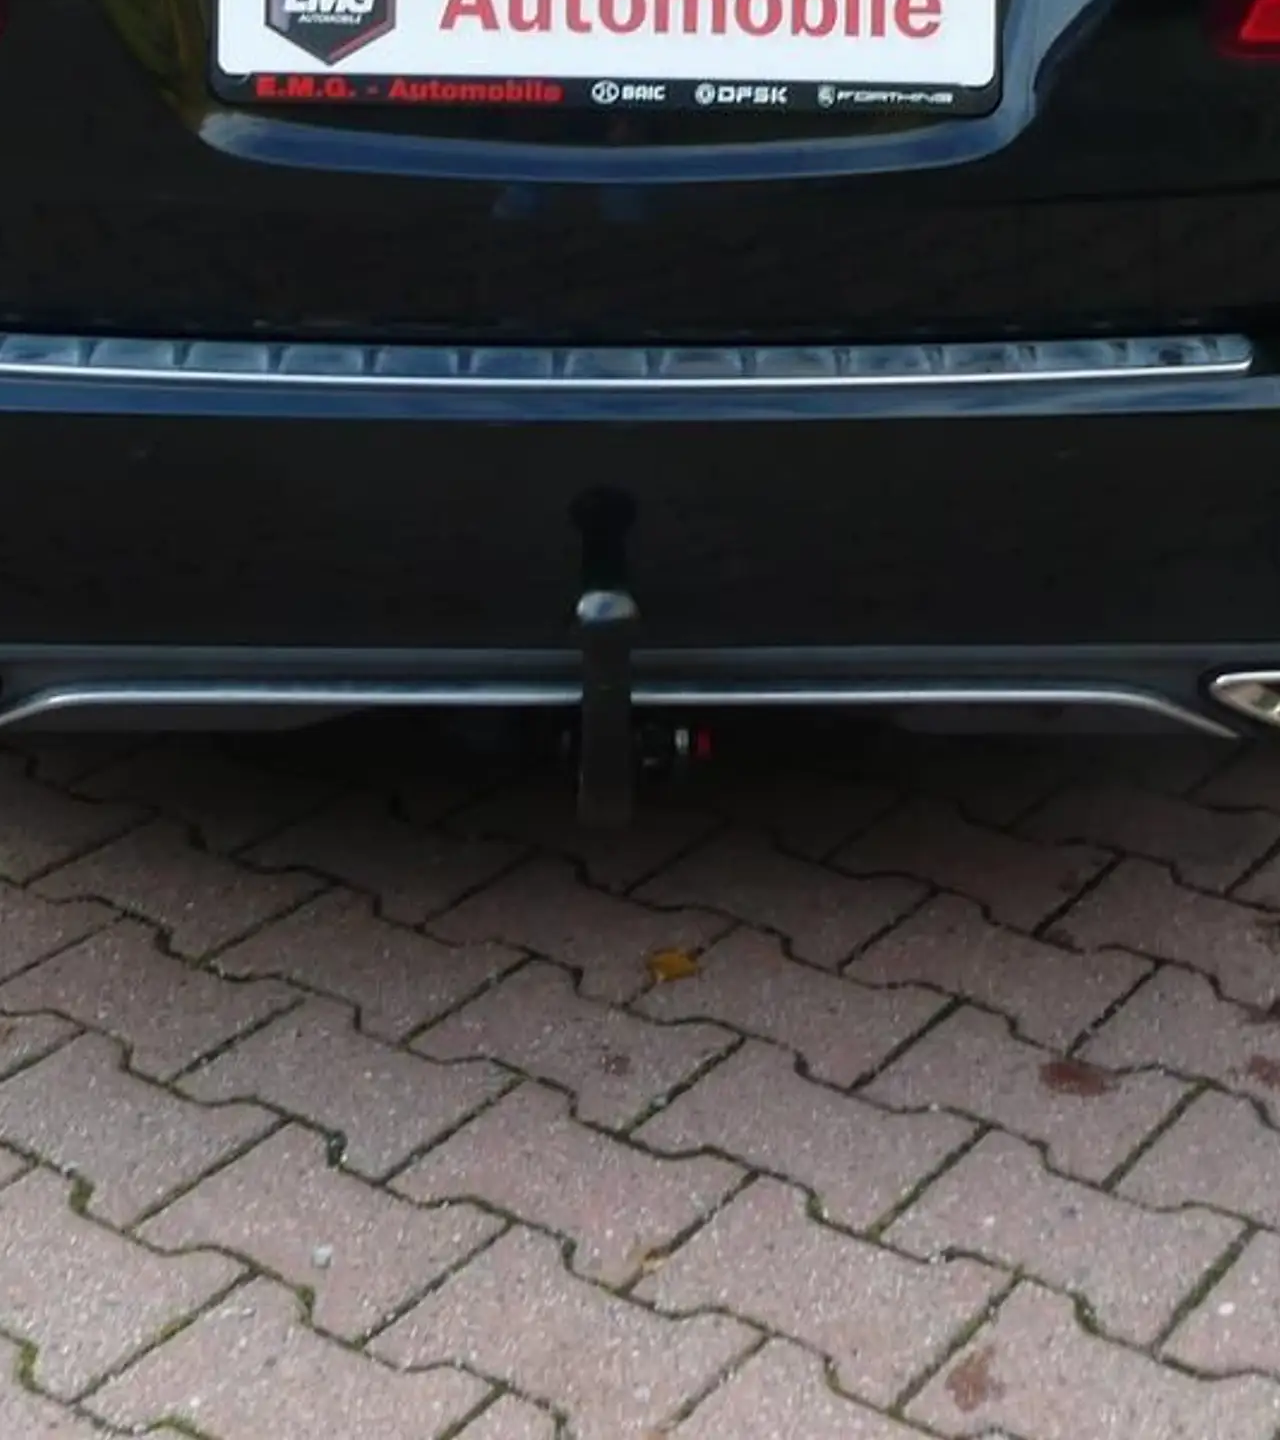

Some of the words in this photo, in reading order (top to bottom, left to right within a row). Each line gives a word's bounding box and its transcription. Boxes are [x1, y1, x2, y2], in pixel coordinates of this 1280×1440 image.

[387, 79, 565, 102] Automobile
[622, 84, 667, 102] BAIC
[718, 85, 789, 104] DFSK
